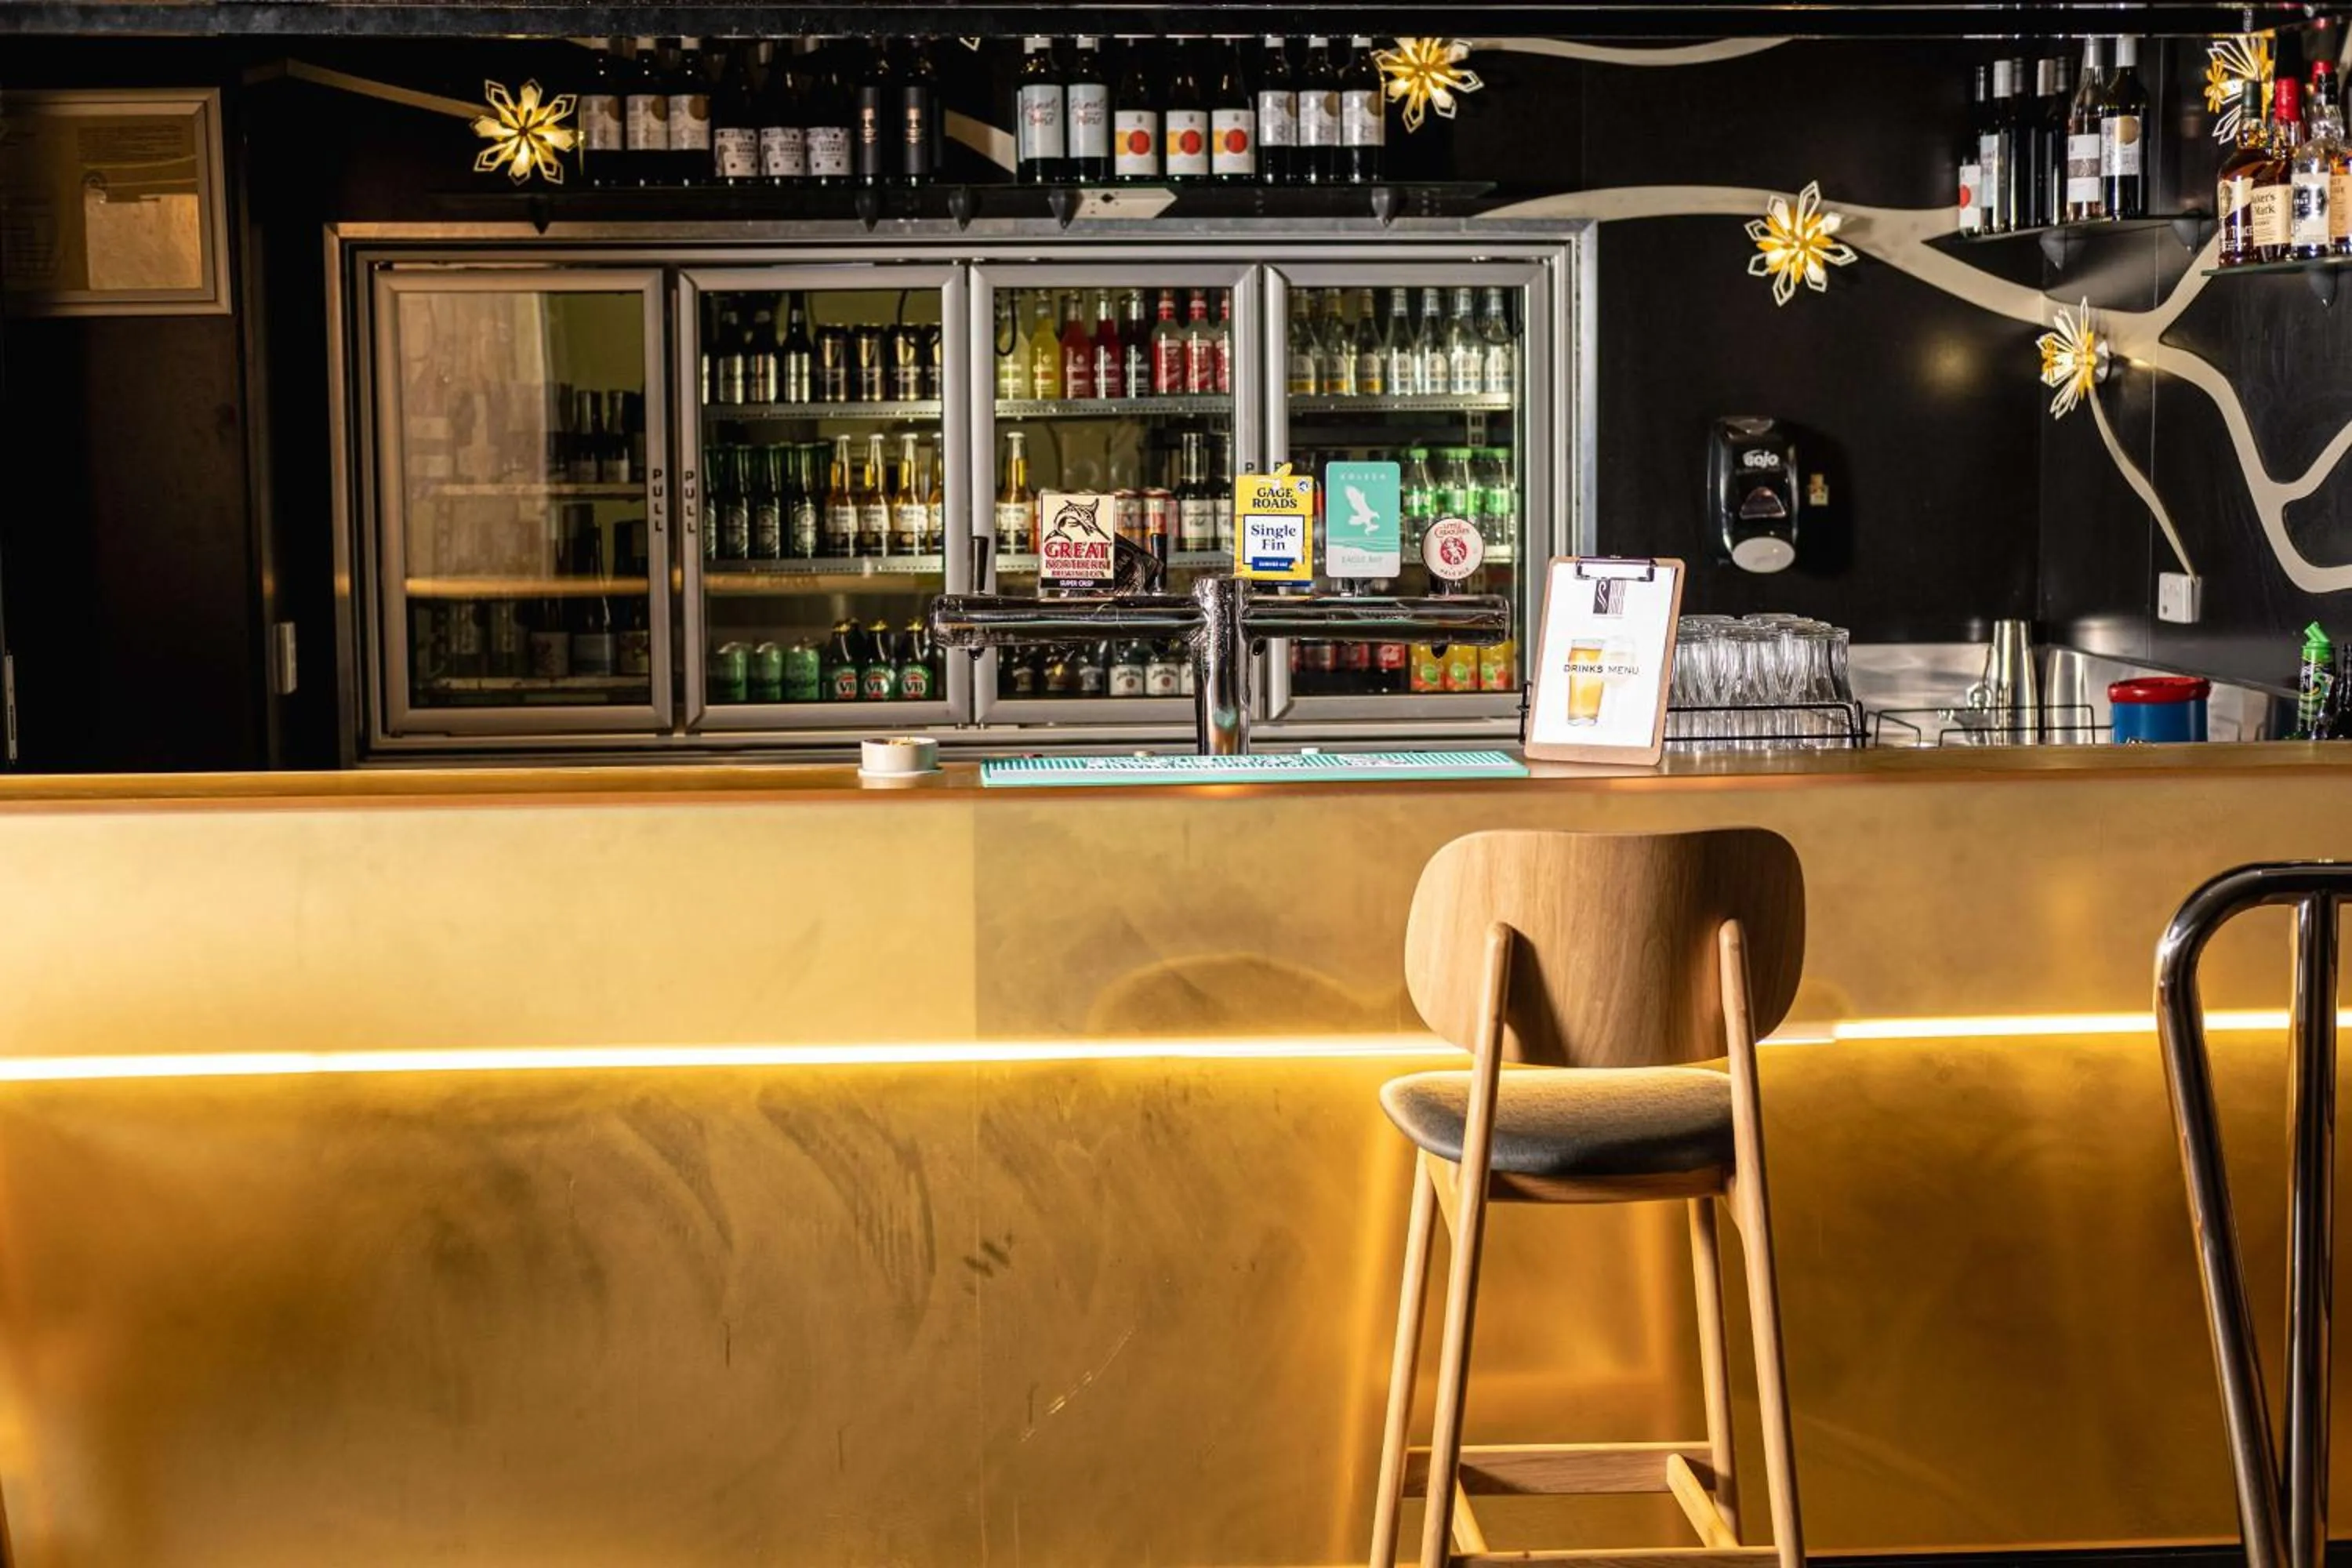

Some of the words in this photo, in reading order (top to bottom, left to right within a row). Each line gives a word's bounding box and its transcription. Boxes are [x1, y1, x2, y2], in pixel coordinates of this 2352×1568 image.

[2251, 194, 2276, 203] aker's
[1257, 487, 1293, 497] GAGE
[652, 468, 663, 532] PULL
[684, 470, 696, 534] PULL
[1252, 498, 1298, 508] ROADS
[1250, 524, 1296, 539] Single
[1044, 541, 1109, 559] GREAT
[1261, 539, 1286, 550] Fin
[1045, 559, 1111, 570] NORTHERN
[1563, 664, 1604, 673] DRINKS
[1608, 665, 1639, 675] MENU
